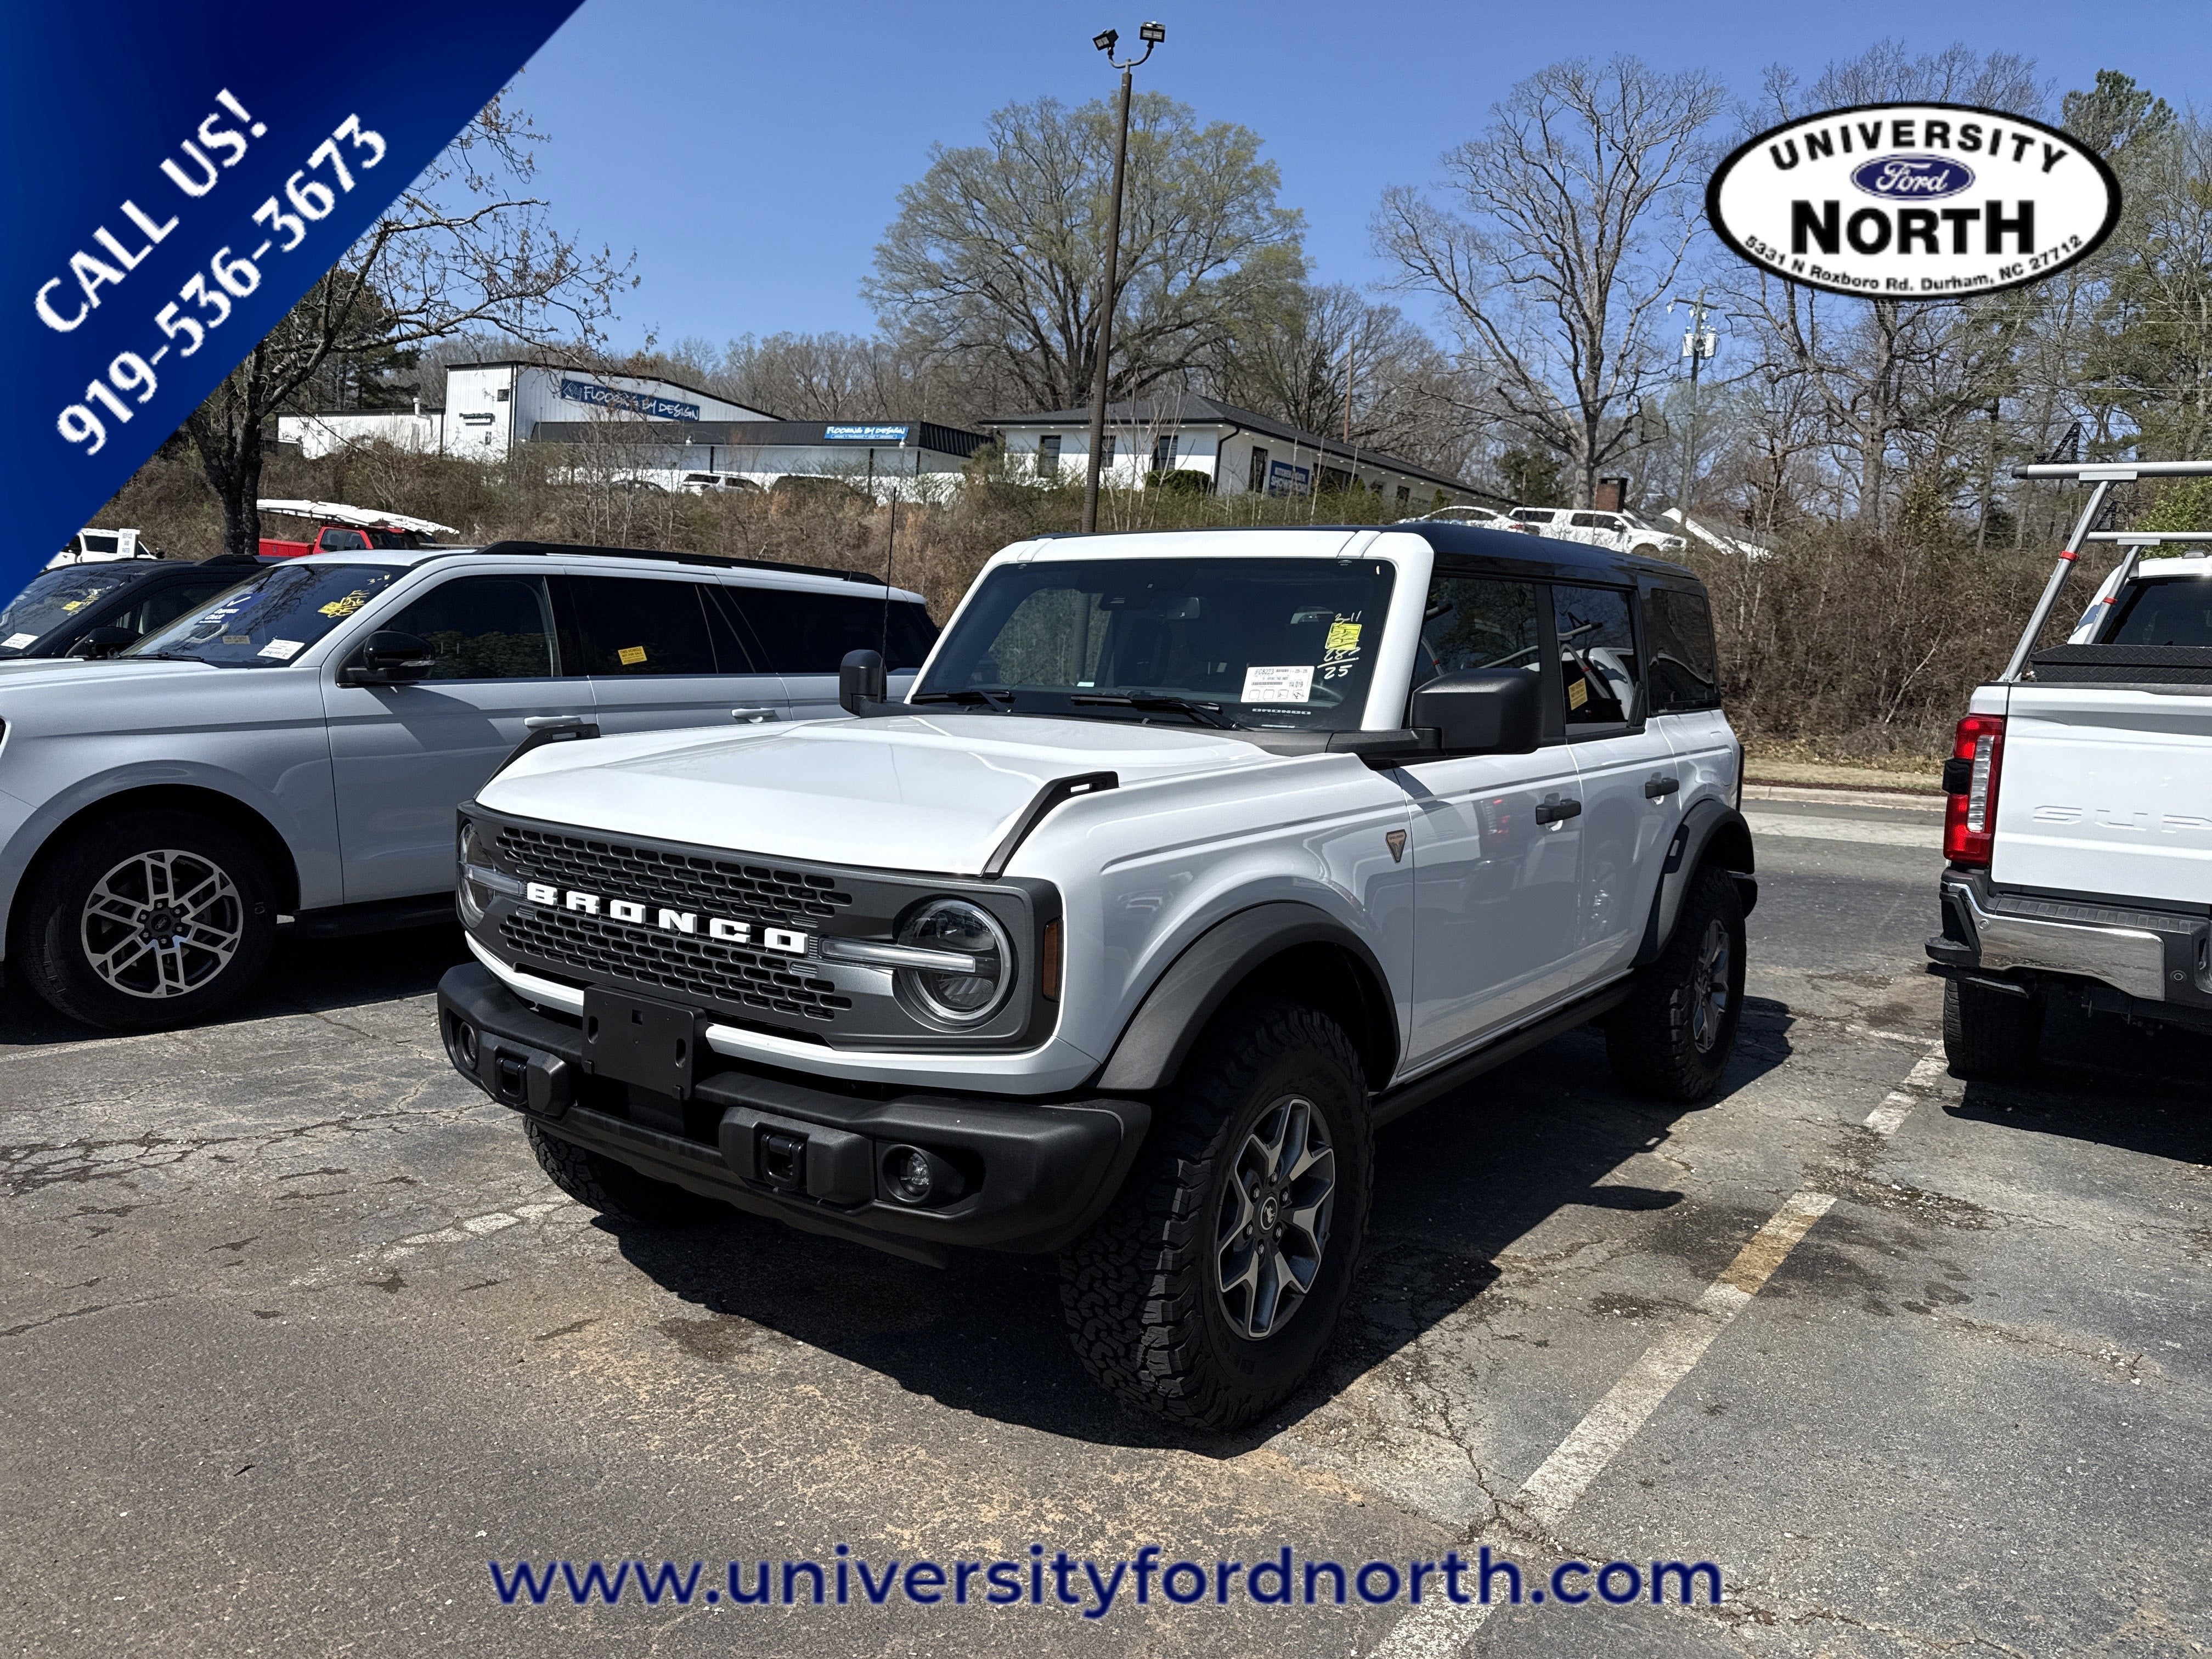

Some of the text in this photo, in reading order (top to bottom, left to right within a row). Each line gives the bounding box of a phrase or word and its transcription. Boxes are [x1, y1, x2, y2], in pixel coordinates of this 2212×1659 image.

[658, 403, 699, 421] DESIGN
[1324, 664, 1353, 679] 25
[527, 882, 809, 954] BRONCO
